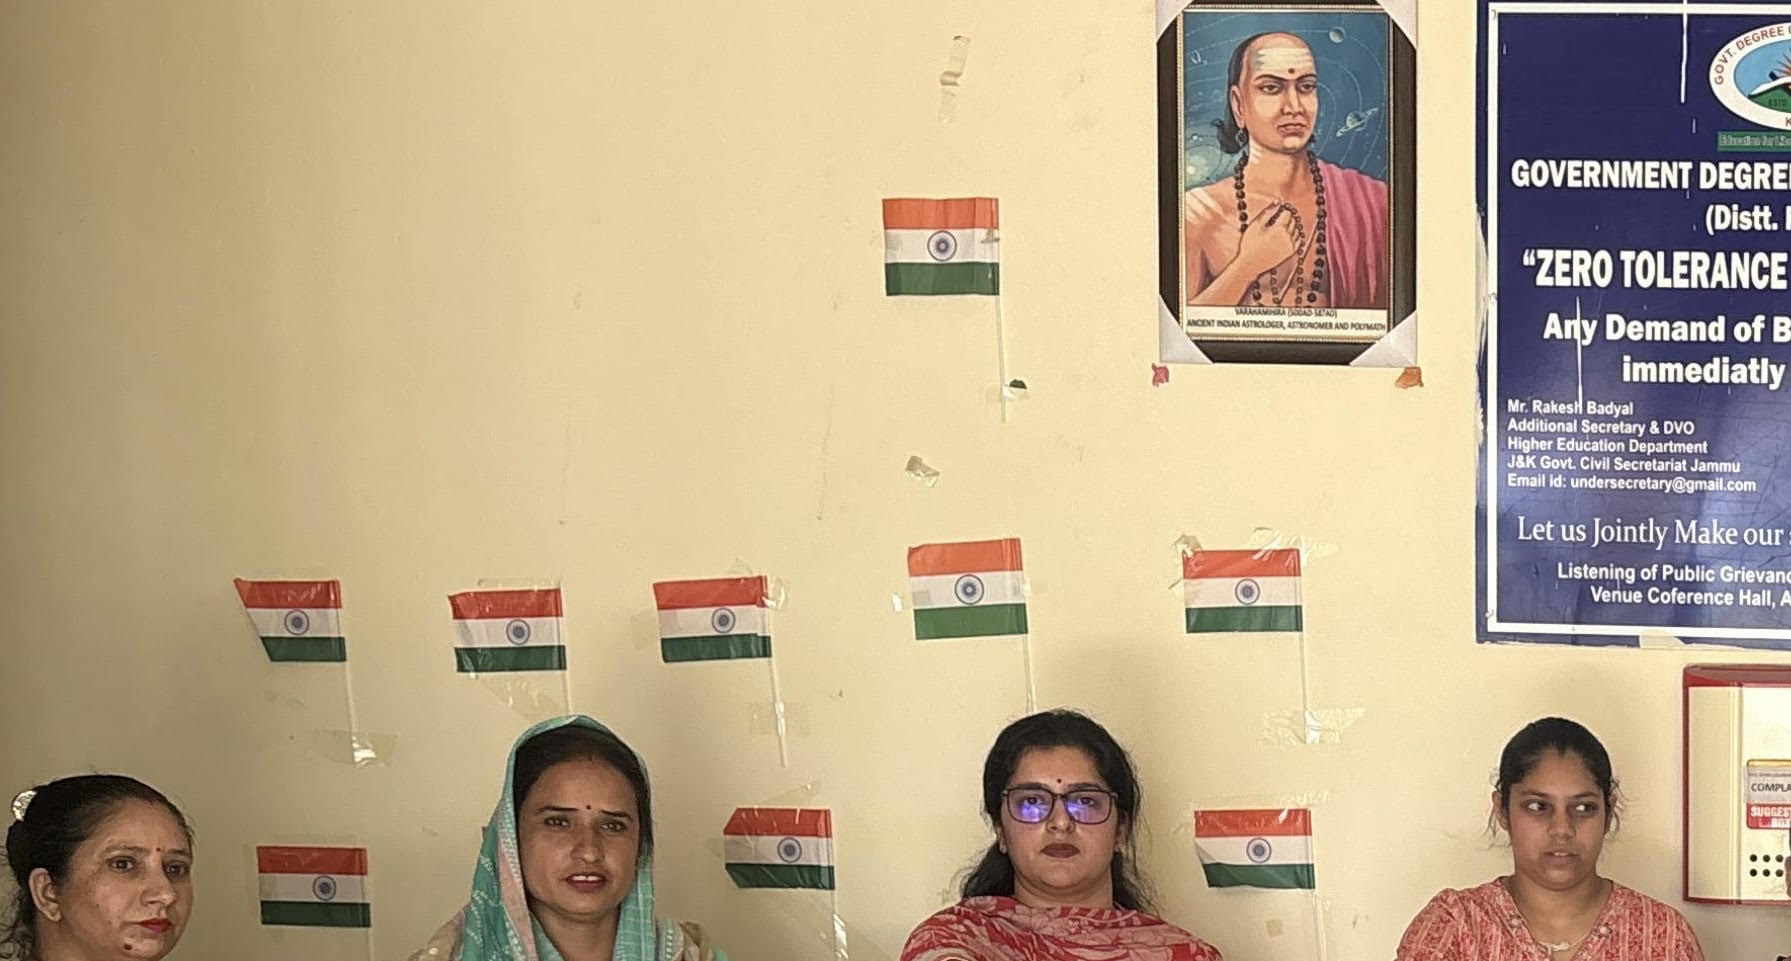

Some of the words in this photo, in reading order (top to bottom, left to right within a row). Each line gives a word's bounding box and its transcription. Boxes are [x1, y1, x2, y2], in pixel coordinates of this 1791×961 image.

[1714, 48, 1737, 86] GOVT.
[1735, 25, 1785, 50] DEGREE
[1512, 160, 1692, 188] GOVERNMENT
[1706, 204, 1778, 235] (Distt.
[1523, 250, 1612, 287] “ZERO
[1620, 251, 1787, 289] TOLERANCE
[1544, 313, 1597, 346] Any
[1606, 314, 1725, 341] Demand
[1734, 315, 1765, 342] of
[1623, 356, 1785, 390] immediatly
[1508, 399, 1528, 412] Mr.
[1533, 400, 1582, 414] Rakesh
[1587, 401, 1633, 418] Badyal
[1508, 418, 1577, 432] Additional
[1581, 419, 1645, 438] Secretary
[1650, 421, 1659, 434] &
[1664, 421, 1694, 435] DVO
[1508, 436, 1553, 453] Higher
[1557, 437, 1624, 452] Education
[1629, 439, 1707, 455] Department
[1507, 455, 1536, 468] J&K
[1540, 456, 1576, 469] Govt.
[1580, 456, 1609, 470] Civil
[1614, 457, 1687, 471] Secretariat
[1691, 459, 1740, 472] Jammu
[1508, 473, 1545, 487] Email
[1550, 474, 1566, 487] id:
[1571, 475, 1756, 493] undersecretary@gmail.com
[1519, 516, 1554, 540] Let
[1561, 525, 1586, 541] us
[1592, 518, 1668, 550] Jointly
[1675, 519, 1738, 544] Make
[1744, 528, 1783, 545] our
[1558, 562, 1635, 584] Listening
[1641, 564, 1658, 580] of
[1663, 565, 1715, 583] Public
[1591, 586, 1642, 603] Venue
[1648, 587, 1734, 605] Coference
[1740, 589, 1775, 608] Hall,
